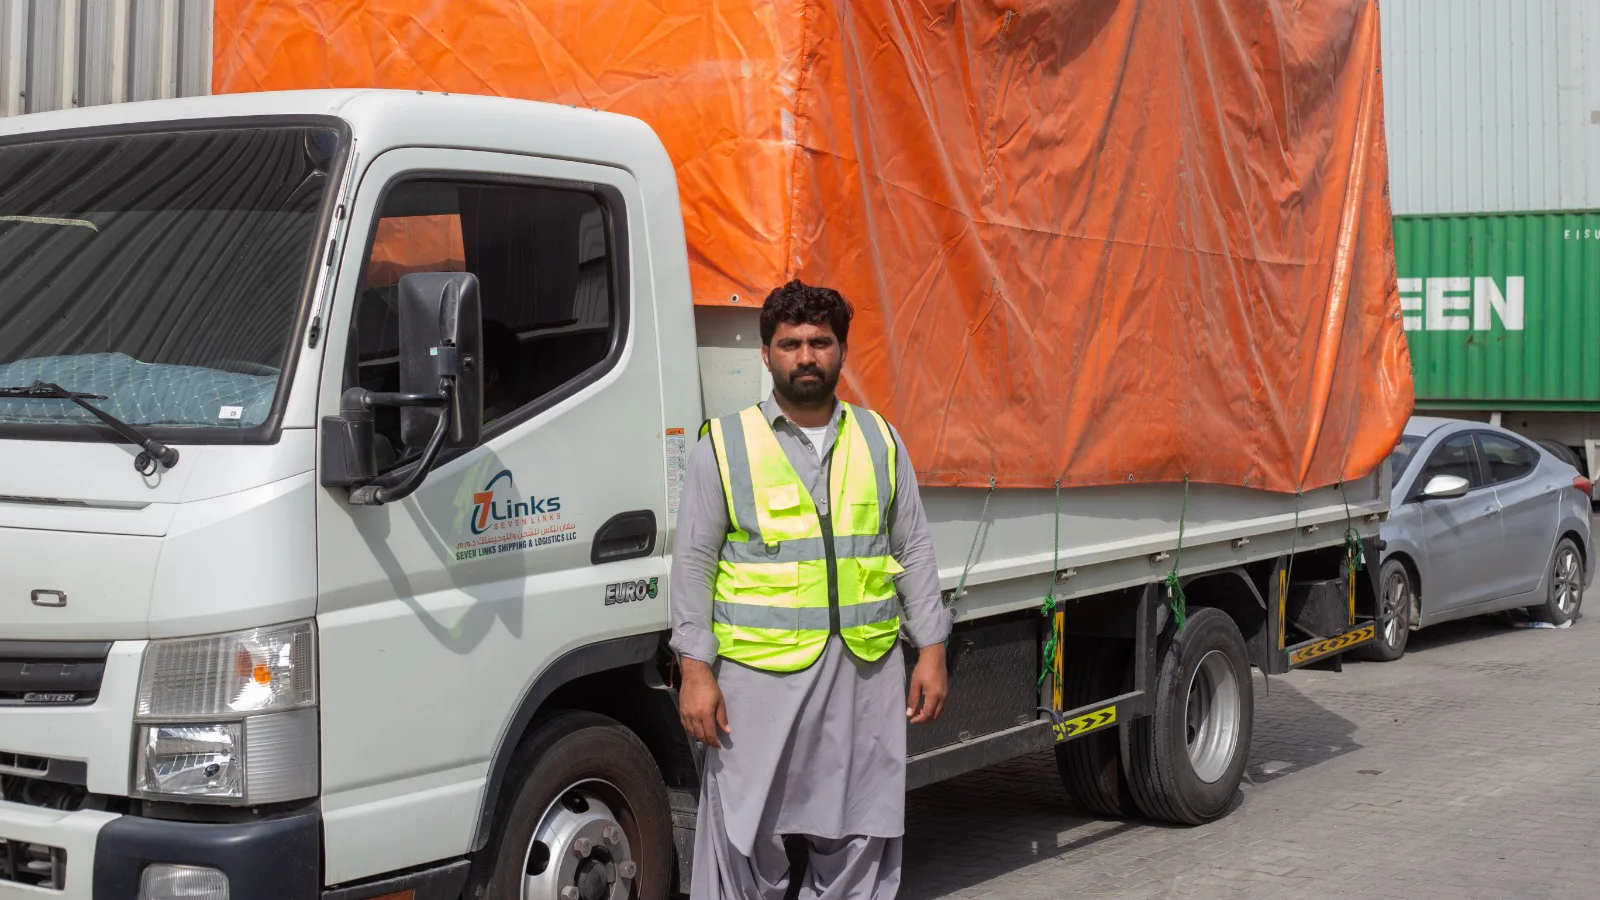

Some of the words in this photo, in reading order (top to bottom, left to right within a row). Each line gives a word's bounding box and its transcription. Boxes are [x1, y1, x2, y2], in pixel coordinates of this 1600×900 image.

[493, 517, 527, 530] SEVEN
[531, 512, 561, 524] LINKS
[455, 549, 477, 561] SEVEN
[478, 545, 497, 557] LINKS
[497, 540, 527, 553] SHIPPING
[528, 539, 533, 548] &
[534, 533, 565, 547] LOGISTICS
[565, 531, 577, 541] LLC
